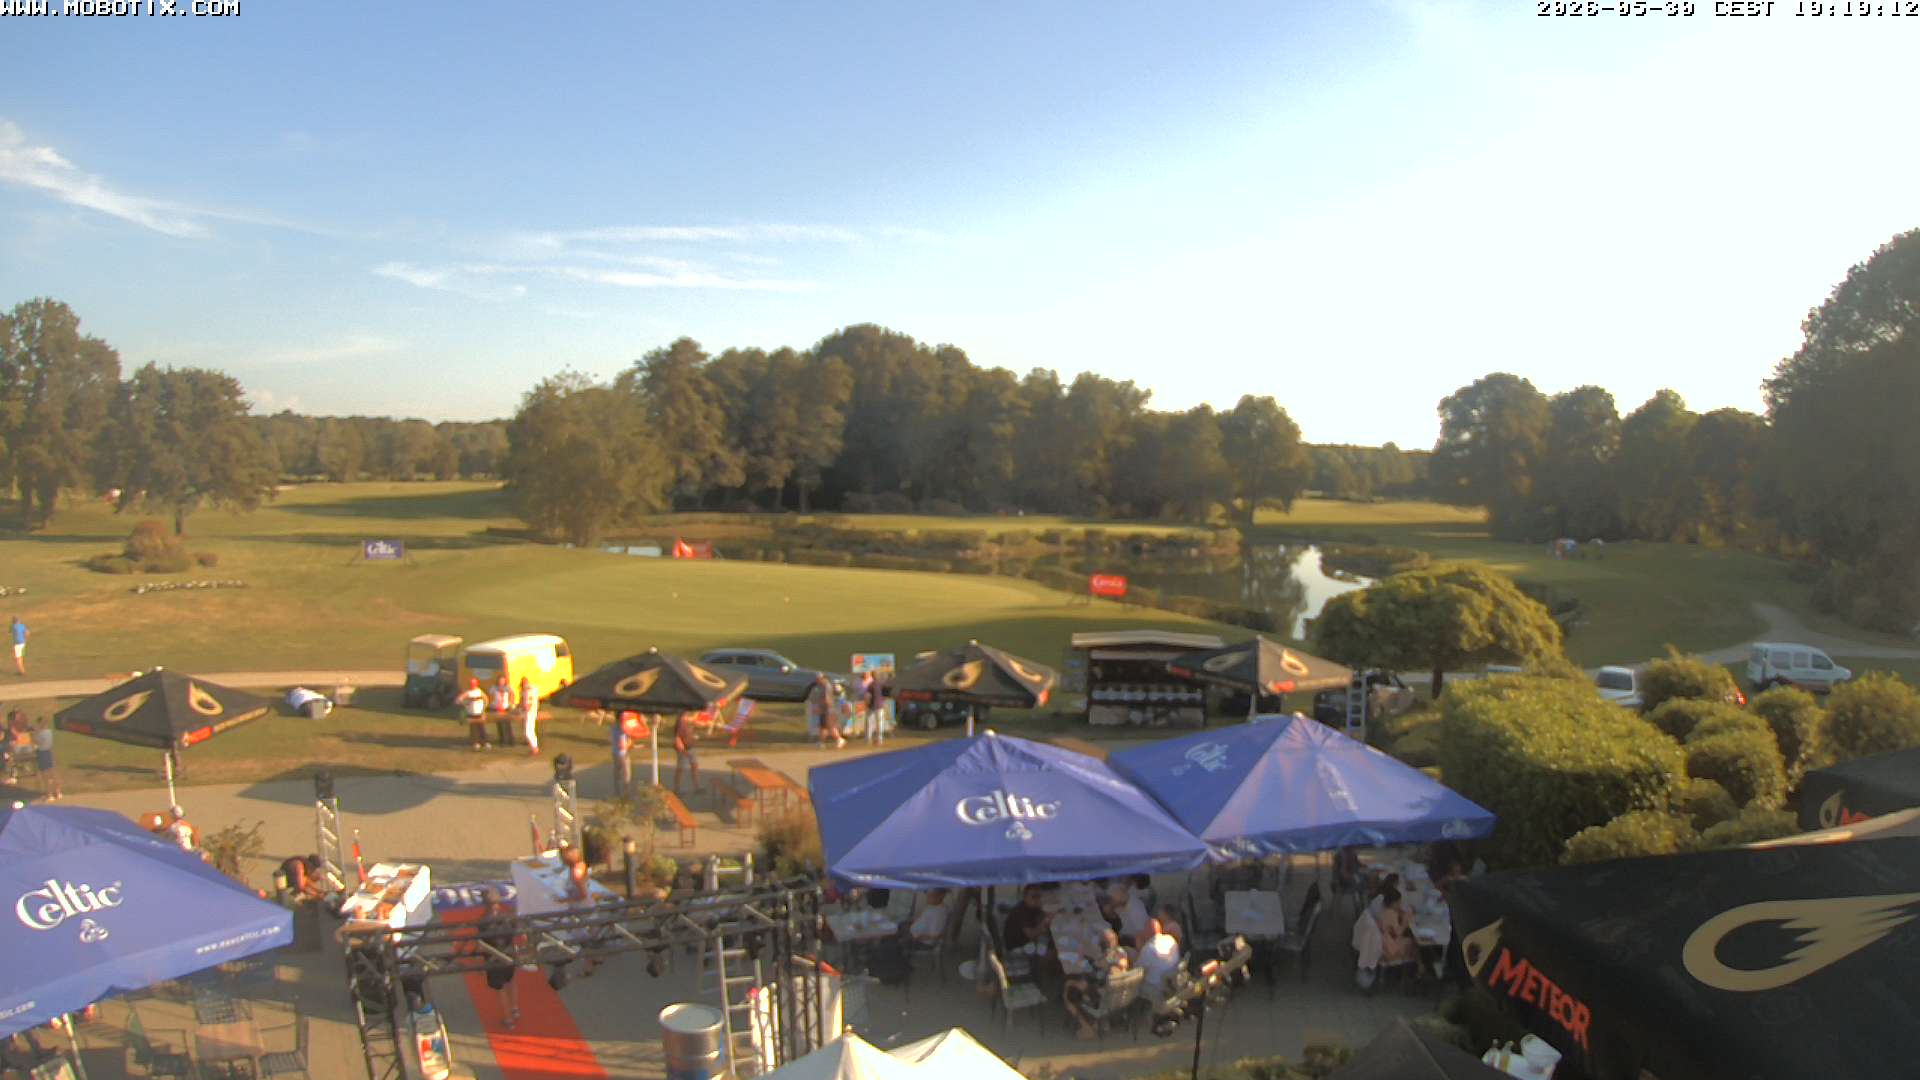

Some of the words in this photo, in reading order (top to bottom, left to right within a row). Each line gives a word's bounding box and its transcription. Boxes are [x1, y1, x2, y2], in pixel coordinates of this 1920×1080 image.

[956, 788, 1058, 825] Celtic
[16, 879, 124, 930] Celtic
[1488, 947, 1590, 1052] METEOR
